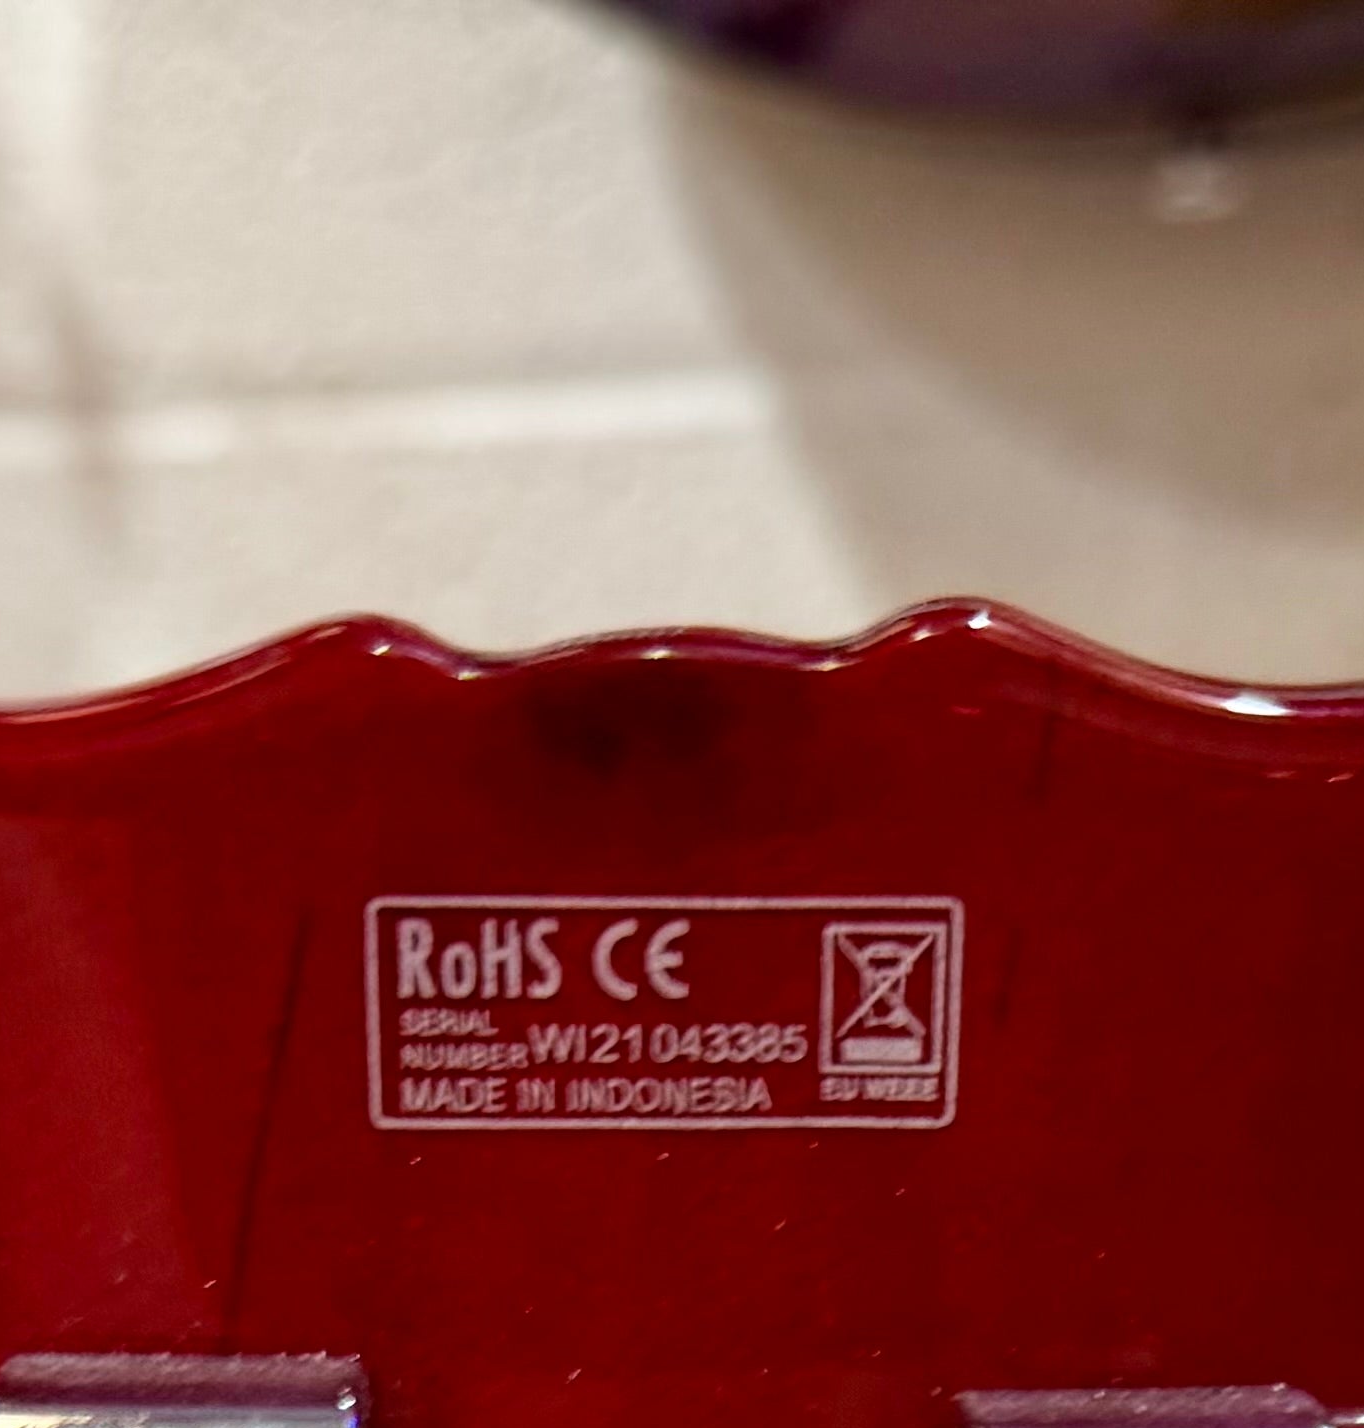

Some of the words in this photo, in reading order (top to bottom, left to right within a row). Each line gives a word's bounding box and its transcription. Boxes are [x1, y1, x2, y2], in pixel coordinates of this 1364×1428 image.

[396, 917, 563, 1000] RoHS
[591, 917, 691, 1001] CE
[398, 1007, 500, 1037] SERIAL
[398, 1042, 529, 1071] NUMBER
[526, 1022, 809, 1065] WI21043385
[398, 1076, 508, 1113] MADE
[515, 1077, 557, 1113] IN
[564, 1076, 774, 1115] INDONESIA
